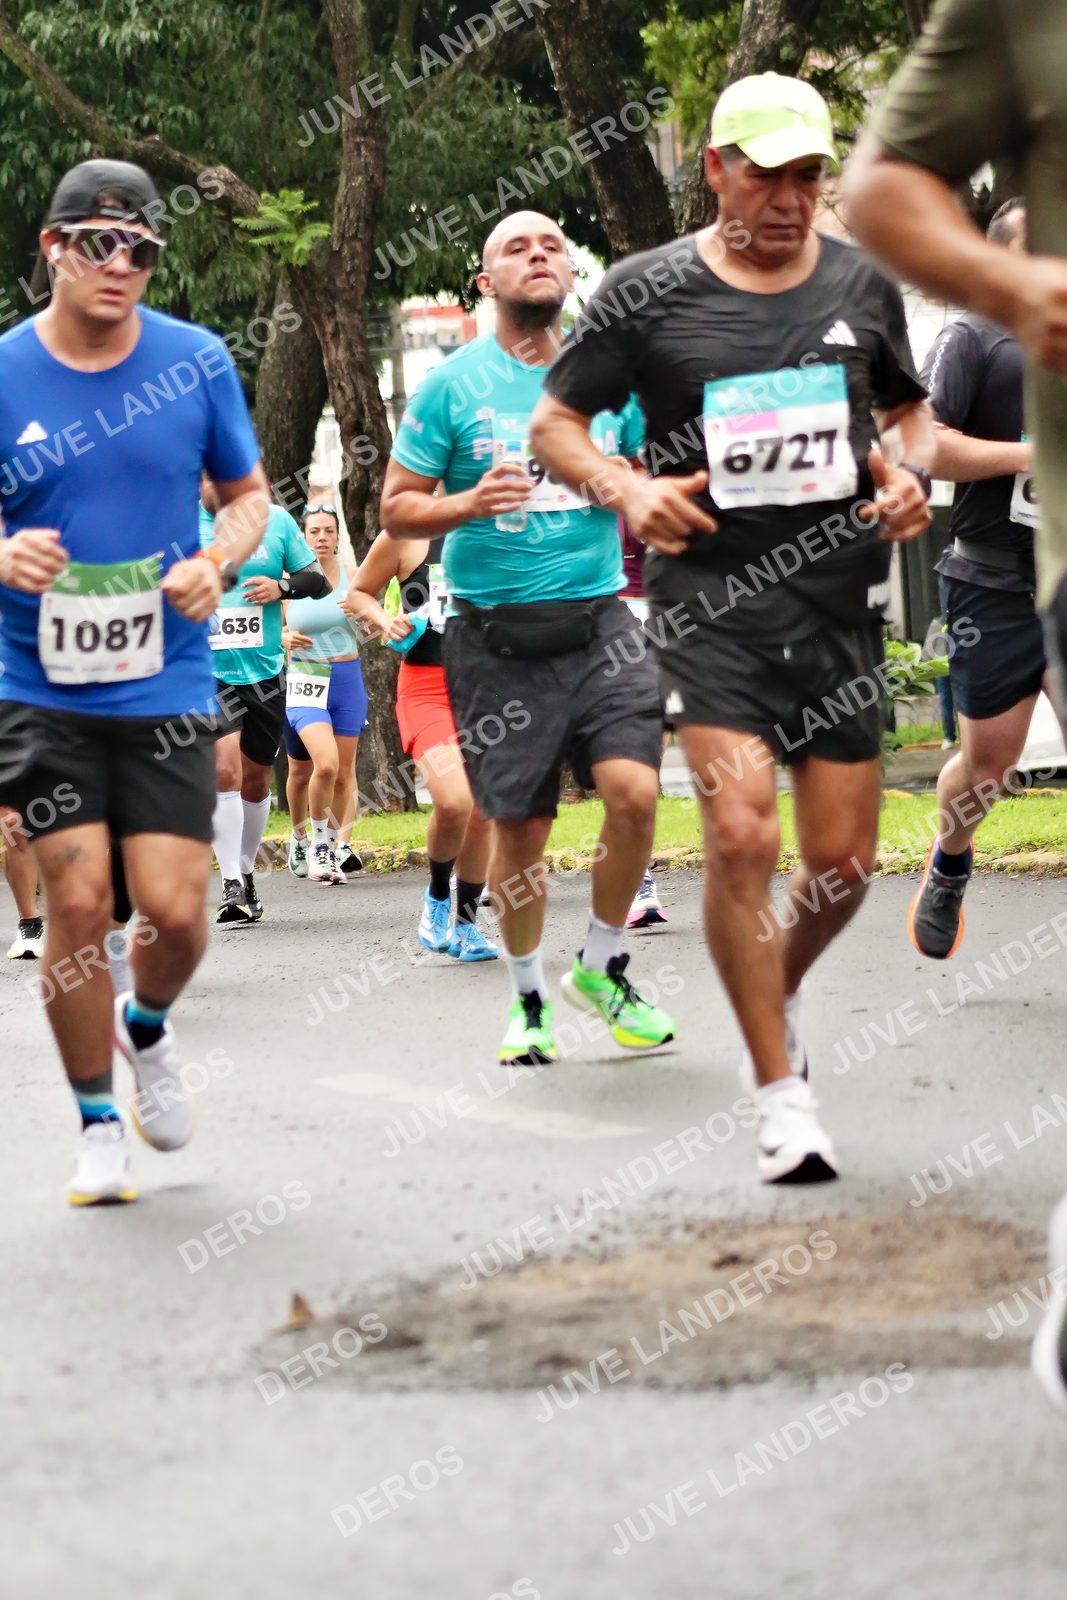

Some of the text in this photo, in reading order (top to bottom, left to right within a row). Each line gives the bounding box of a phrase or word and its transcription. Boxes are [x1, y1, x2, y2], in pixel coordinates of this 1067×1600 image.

[723, 429, 838, 474] 6727
[51, 613, 155, 653] 1087
[211, 617, 260, 635] 636
[287, 682, 325, 698] 1587
